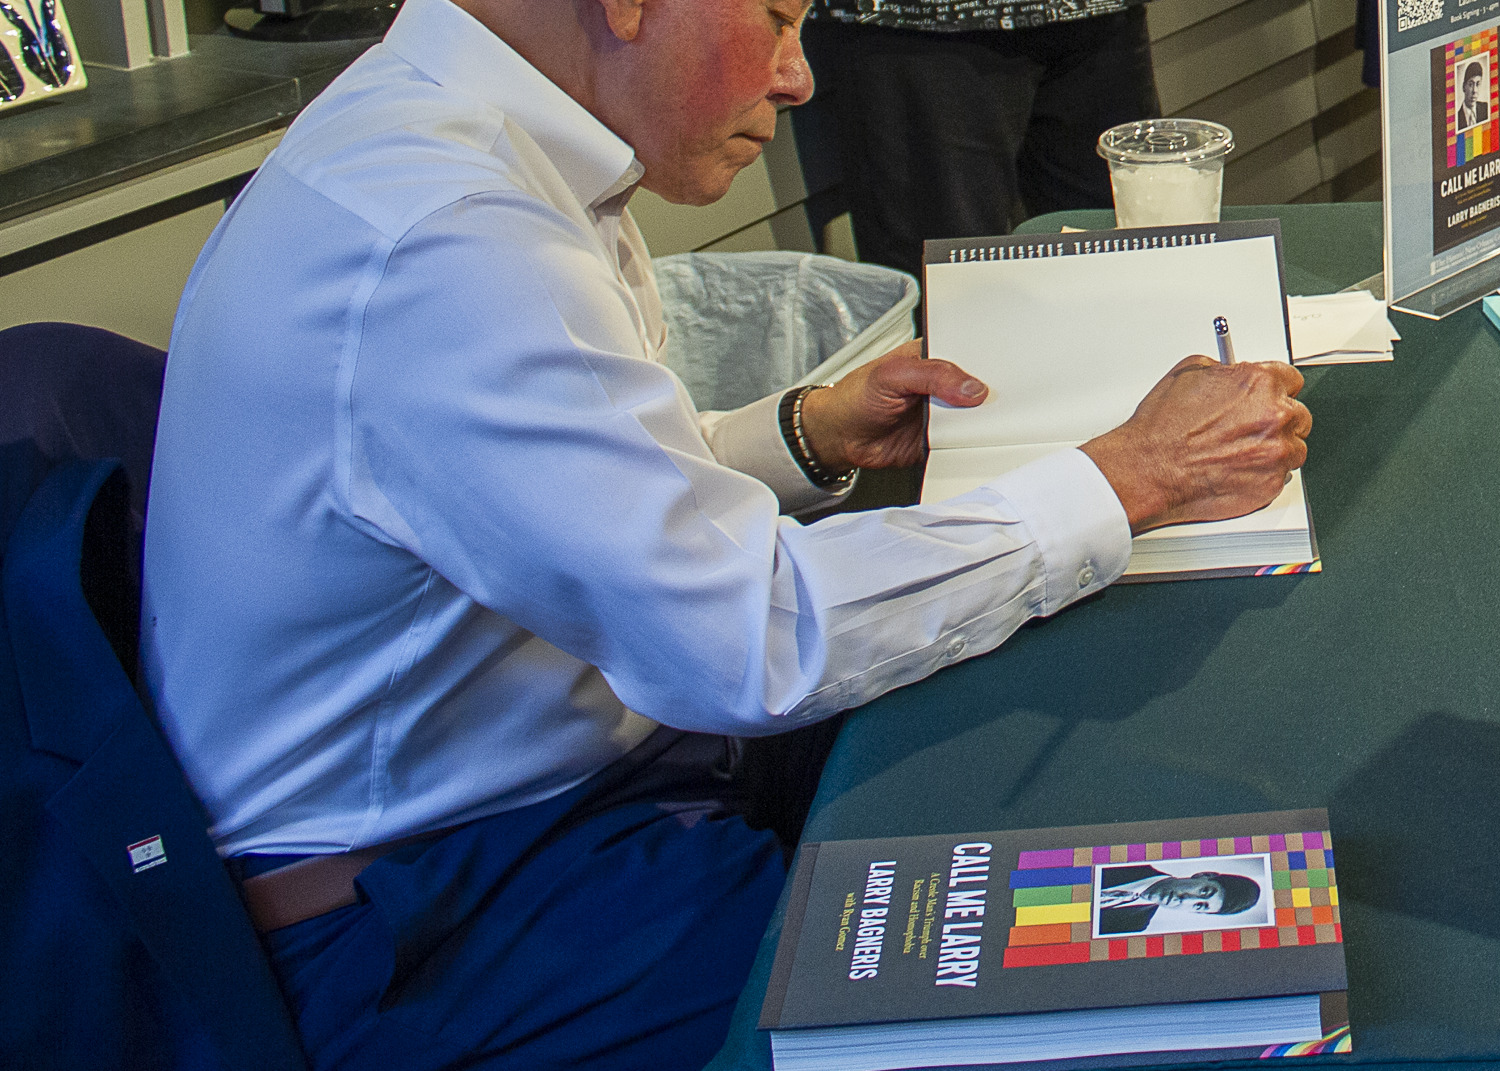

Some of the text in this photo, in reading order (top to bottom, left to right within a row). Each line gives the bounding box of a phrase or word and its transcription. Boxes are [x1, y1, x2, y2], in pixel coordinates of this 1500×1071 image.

[1450, 14, 1462, 24] Book
[1462, 8, 1480, 20] Signing
[1440, 177, 1463, 198] CALL
[1464, 168, 1479, 186] ME
[1447, 208, 1469, 228] LARRY
[1469, 195, 1500, 219] BAGNERIS
[844, 892, 857, 909] with
[935, 841, 993, 988] CALL ME LARRY
[848, 860, 897, 980] LARRY BAGNERIS
[903, 879, 925, 954] Racism and Homophobia
[919, 916, 935, 945] Triumph
[918, 946, 928, 959] over
